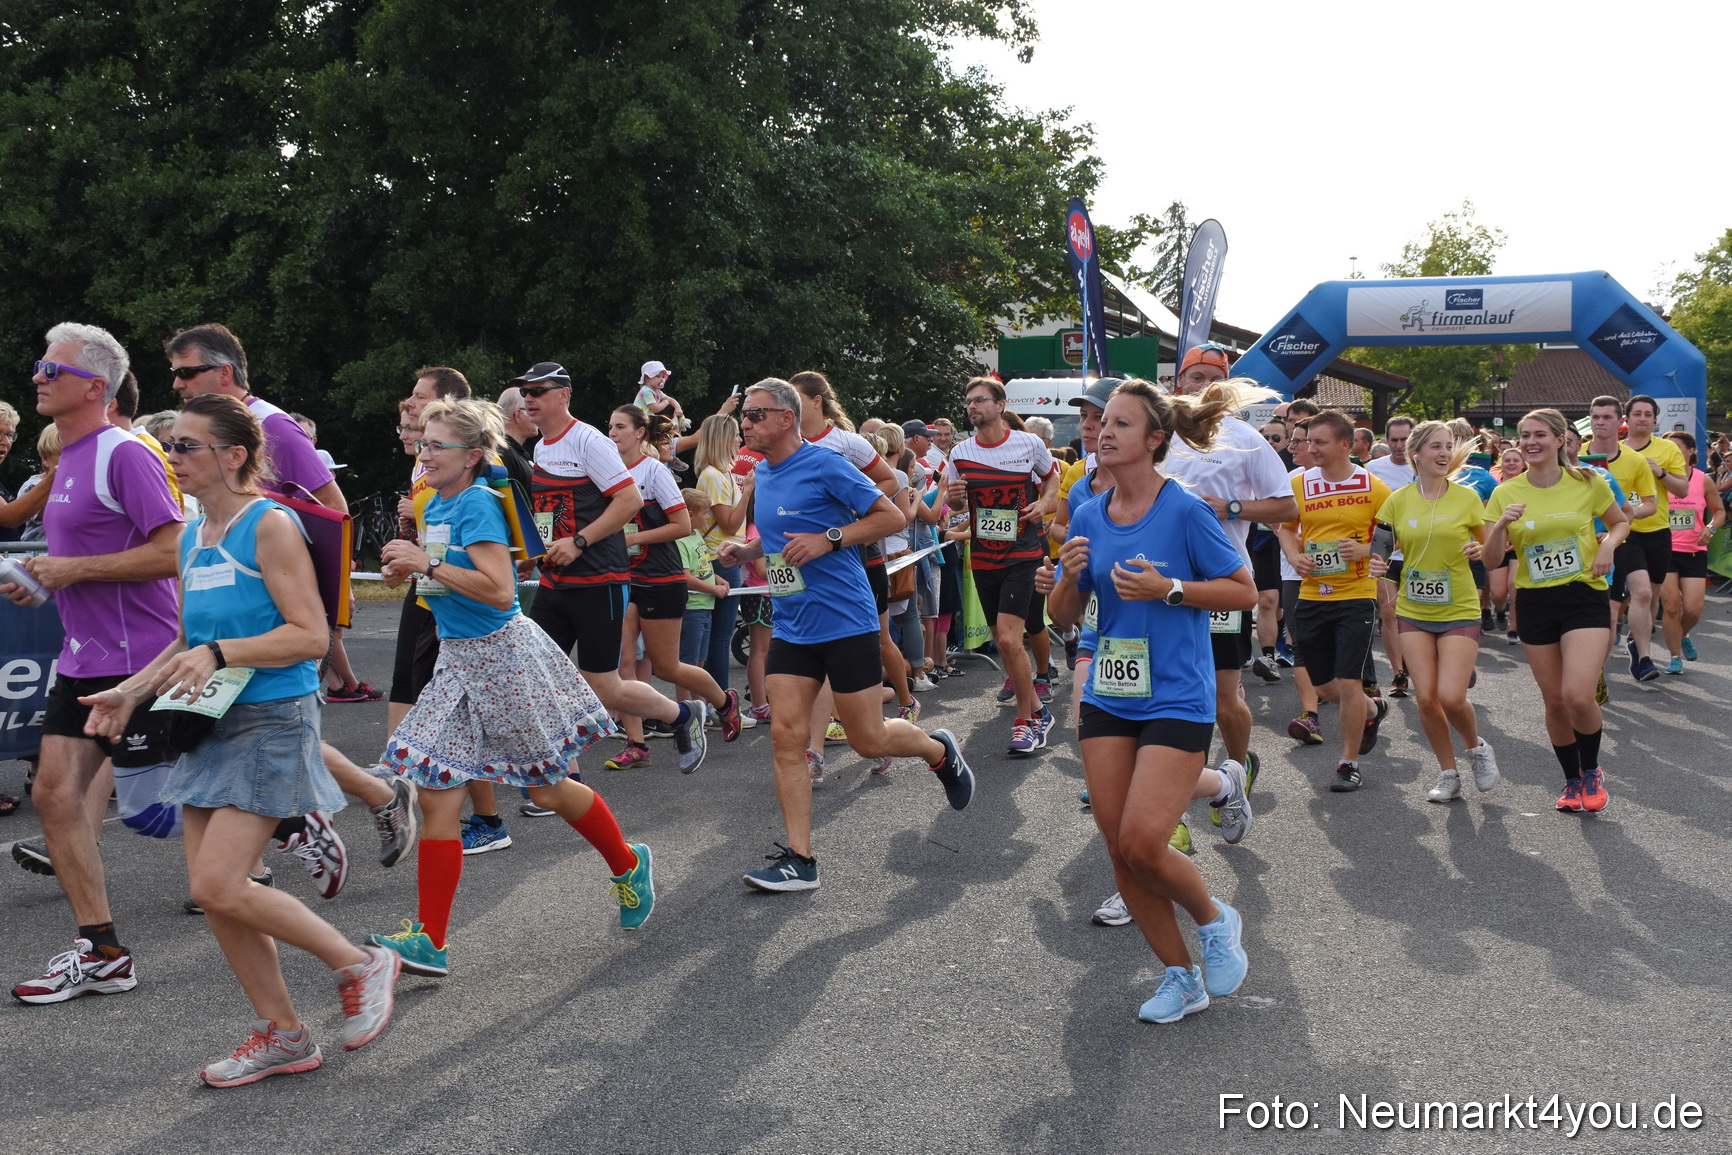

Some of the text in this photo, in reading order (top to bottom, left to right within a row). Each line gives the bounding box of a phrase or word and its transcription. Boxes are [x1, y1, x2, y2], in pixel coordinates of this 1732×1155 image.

[1203, 247, 1219, 307] AUTOMOBILE
[1453, 295, 1482, 303] Fischer
[1431, 308, 1516, 326] firmenlauf
[1277, 336, 1320, 351] Fischer
[1305, 495, 1372, 513] MAX BÖGL
[981, 519, 1011, 532] 2248
[1533, 551, 1574, 572] 1215
[768, 567, 795, 585] 1088
[1409, 581, 1445, 596] 1256
[1099, 658, 1140, 681] 1086
